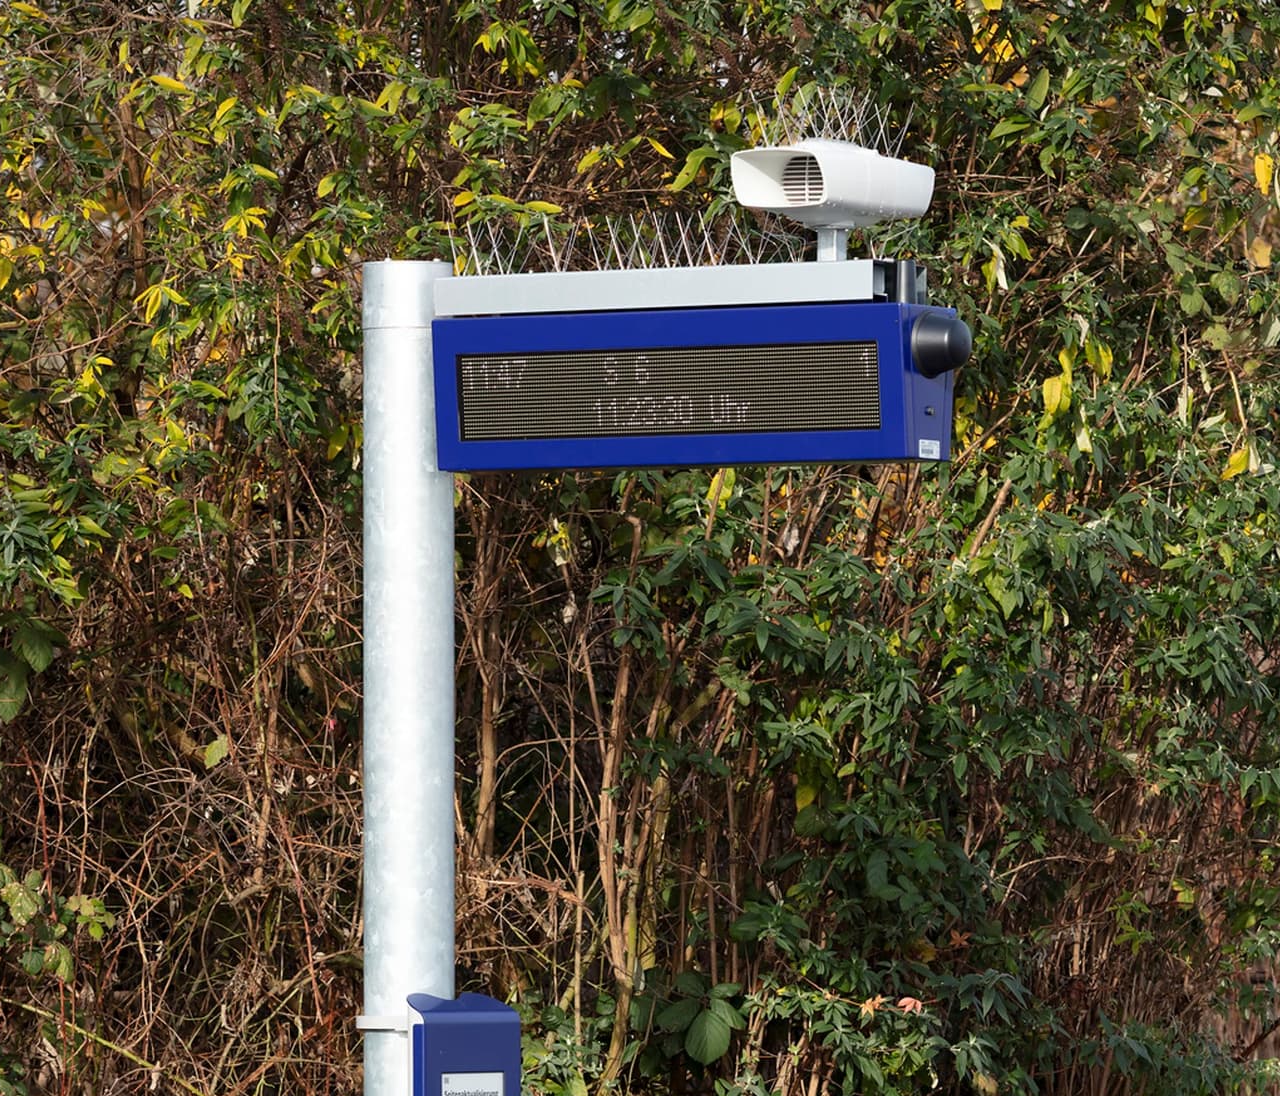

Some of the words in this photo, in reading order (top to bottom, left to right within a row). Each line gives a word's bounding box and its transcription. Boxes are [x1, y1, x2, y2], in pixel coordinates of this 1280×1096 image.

[463, 360, 527, 389] 11:47
[604, 357, 618, 385] S
[635, 356, 649, 384] 6
[859, 348, 869, 377] 1
[592, 395, 694, 426] 11:23:30
[709, 394, 751, 423] Uhr
